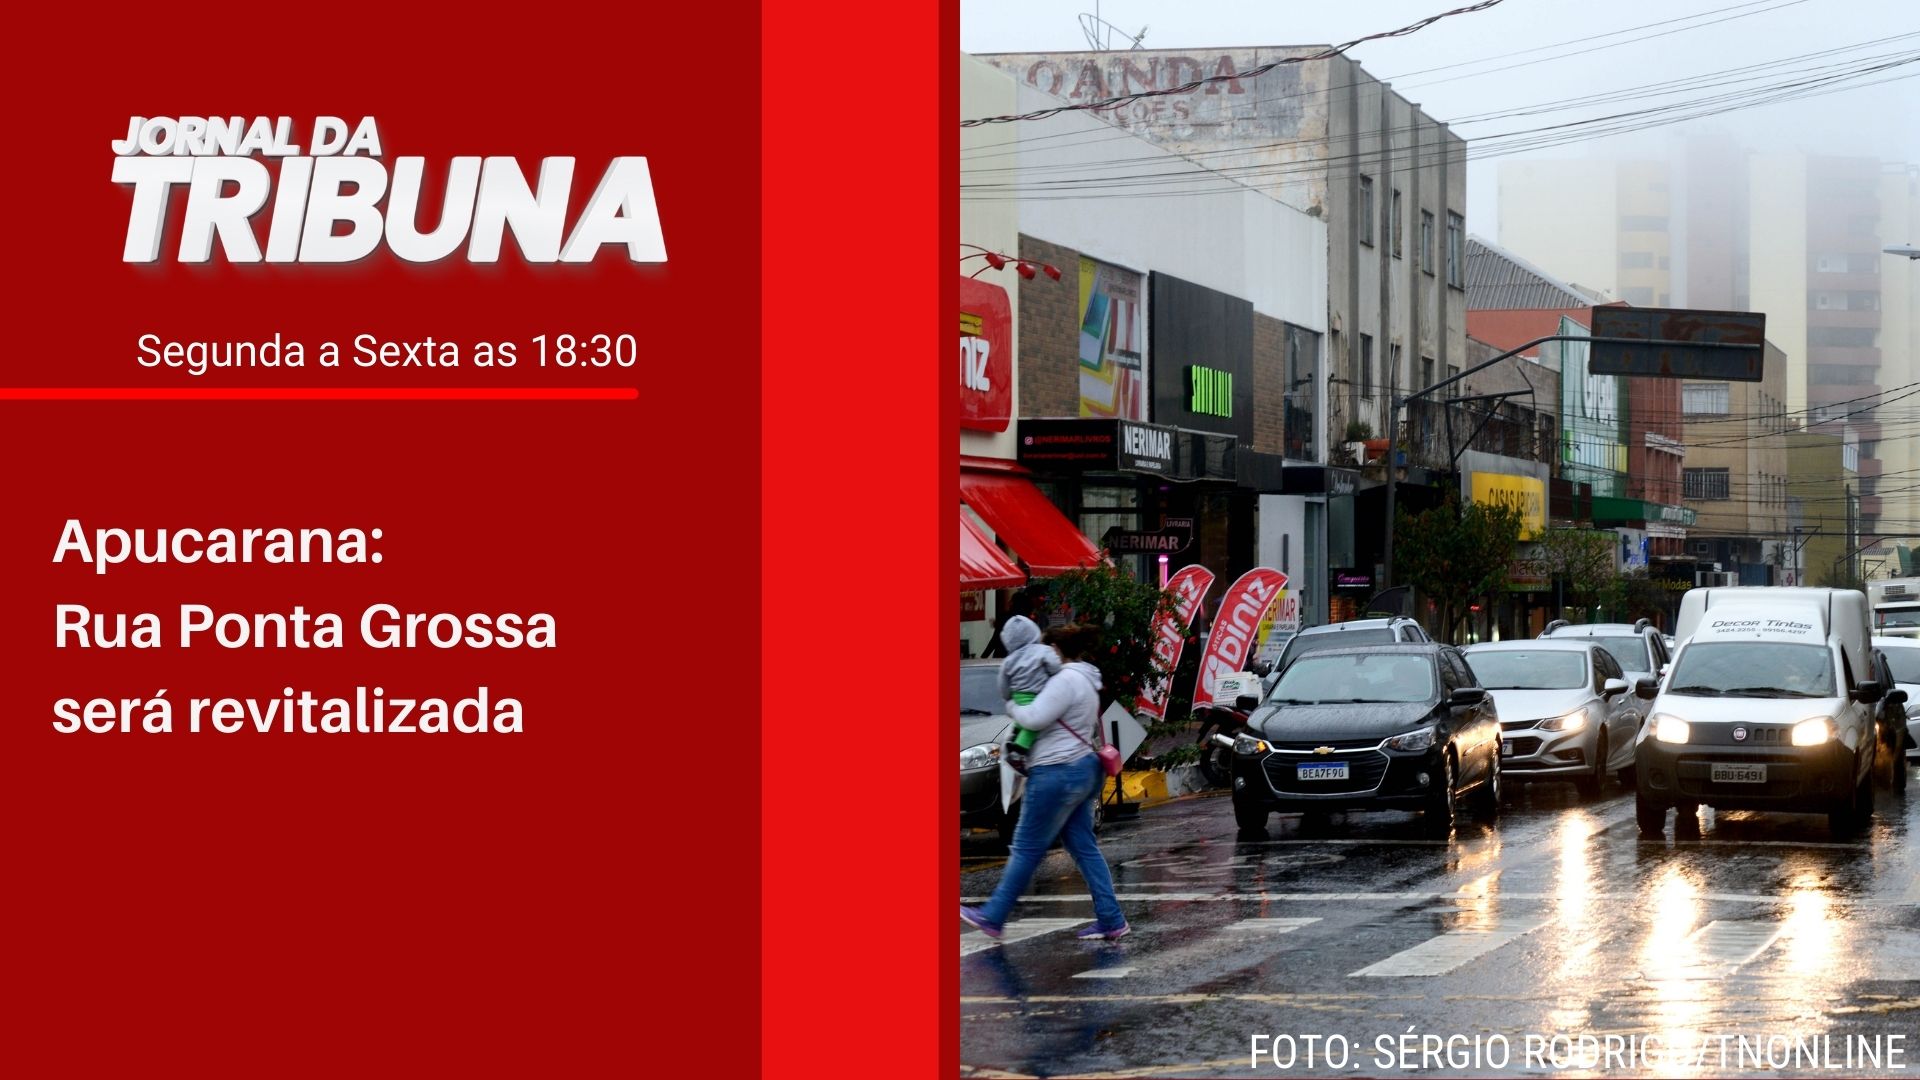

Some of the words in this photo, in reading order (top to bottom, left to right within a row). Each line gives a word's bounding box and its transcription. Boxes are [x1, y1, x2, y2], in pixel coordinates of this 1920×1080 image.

[1024, 55, 1245, 100] OANDA
[1124, 425, 1171, 460] NERIMAR
[1109, 536, 1179, 550] NERIMAR
[1766, 619, 1813, 630] Tintas
